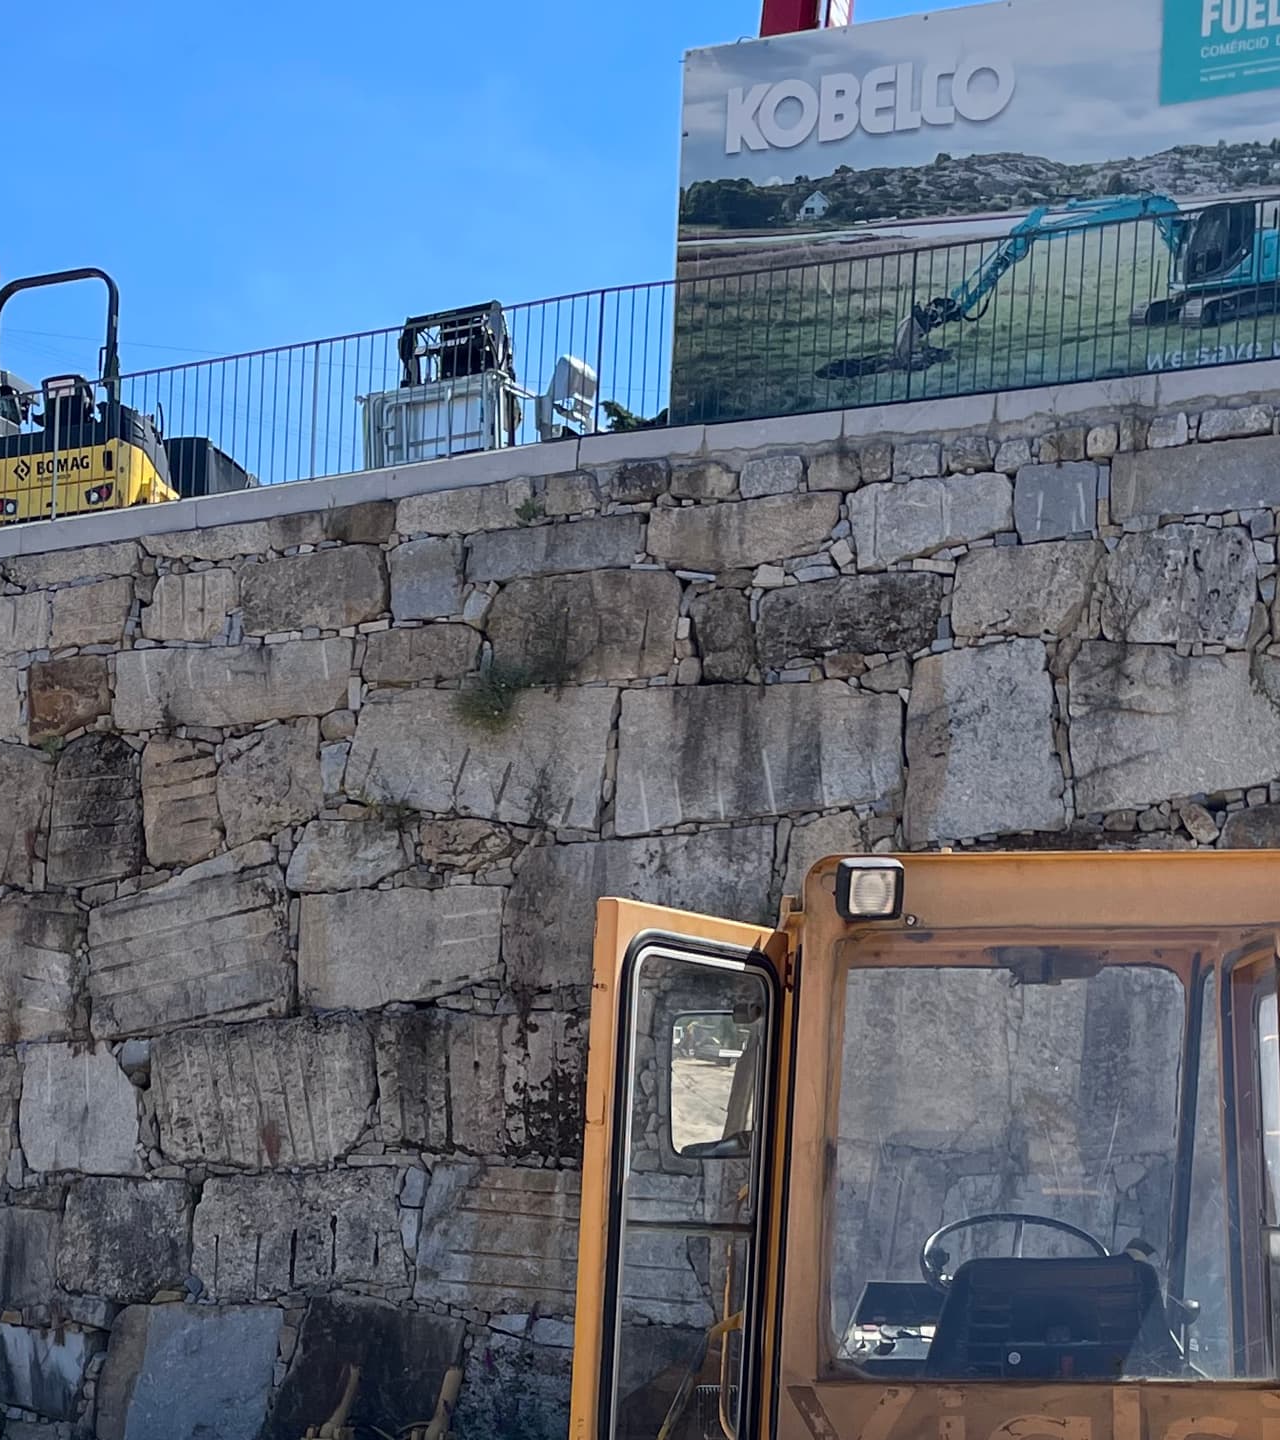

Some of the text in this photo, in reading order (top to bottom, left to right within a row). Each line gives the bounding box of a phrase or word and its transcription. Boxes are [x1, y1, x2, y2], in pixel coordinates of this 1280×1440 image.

[1200, 36, 1269, 58] COMÉRCIO
[725, 53, 1016, 155] KOBELCO
[1146, 350, 1187, 370] we
[1193, 341, 1262, 366] save
[36, 455, 90, 475] BOMAG
